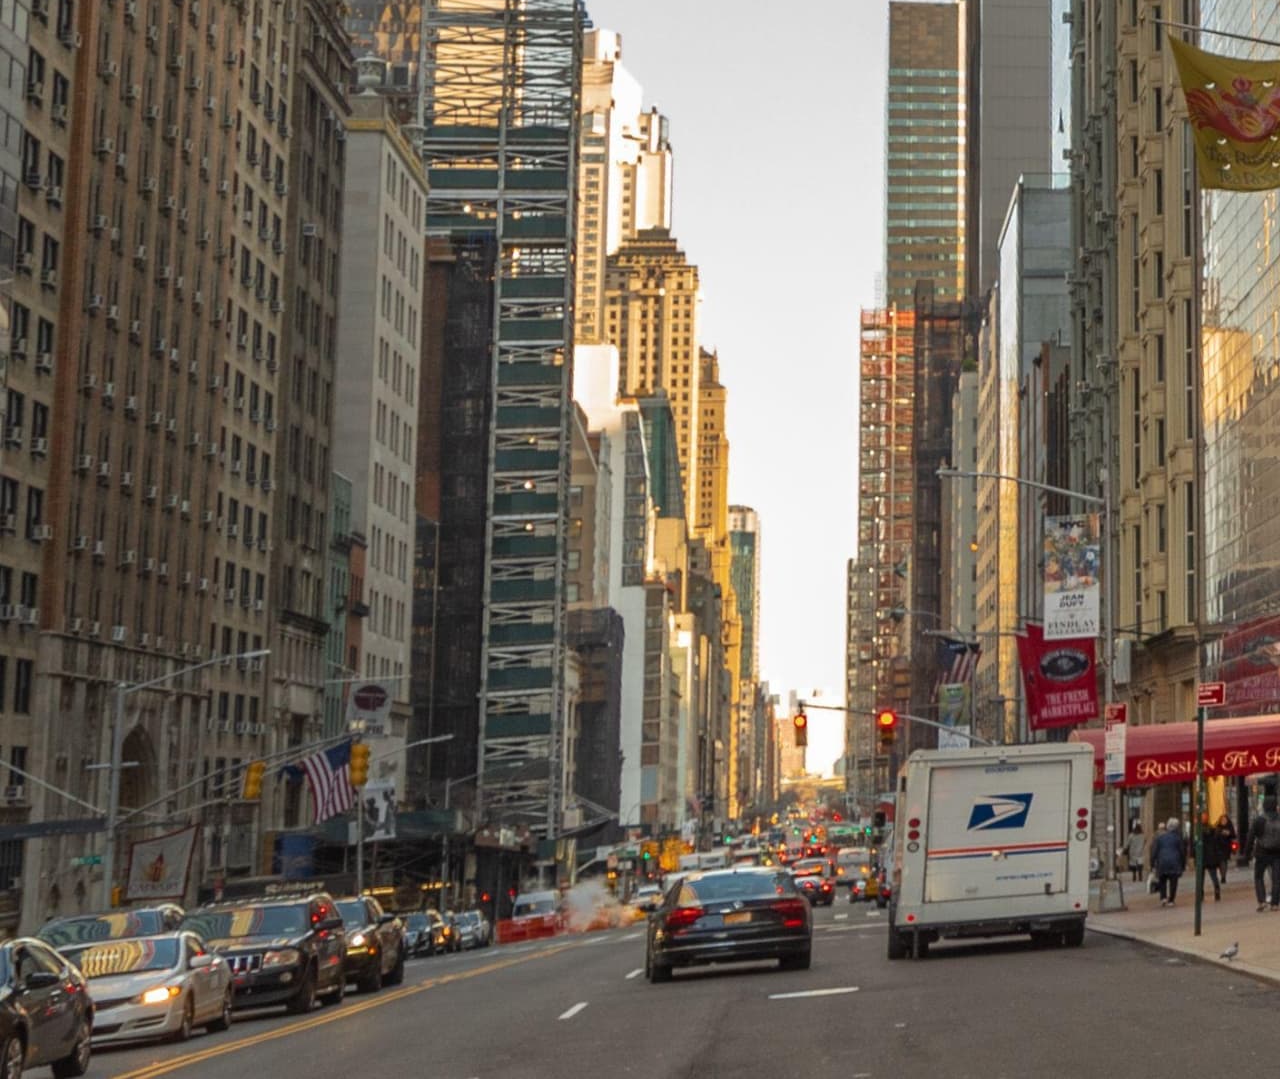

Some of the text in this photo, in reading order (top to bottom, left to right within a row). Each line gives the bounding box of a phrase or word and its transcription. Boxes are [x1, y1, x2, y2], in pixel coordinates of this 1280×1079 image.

[1060, 593, 1085, 602] JEAN
[1059, 601, 1085, 609] DUFY
[1136, 758, 1216, 780] RUSSIAN
[1221, 749, 1259, 771] TEA
